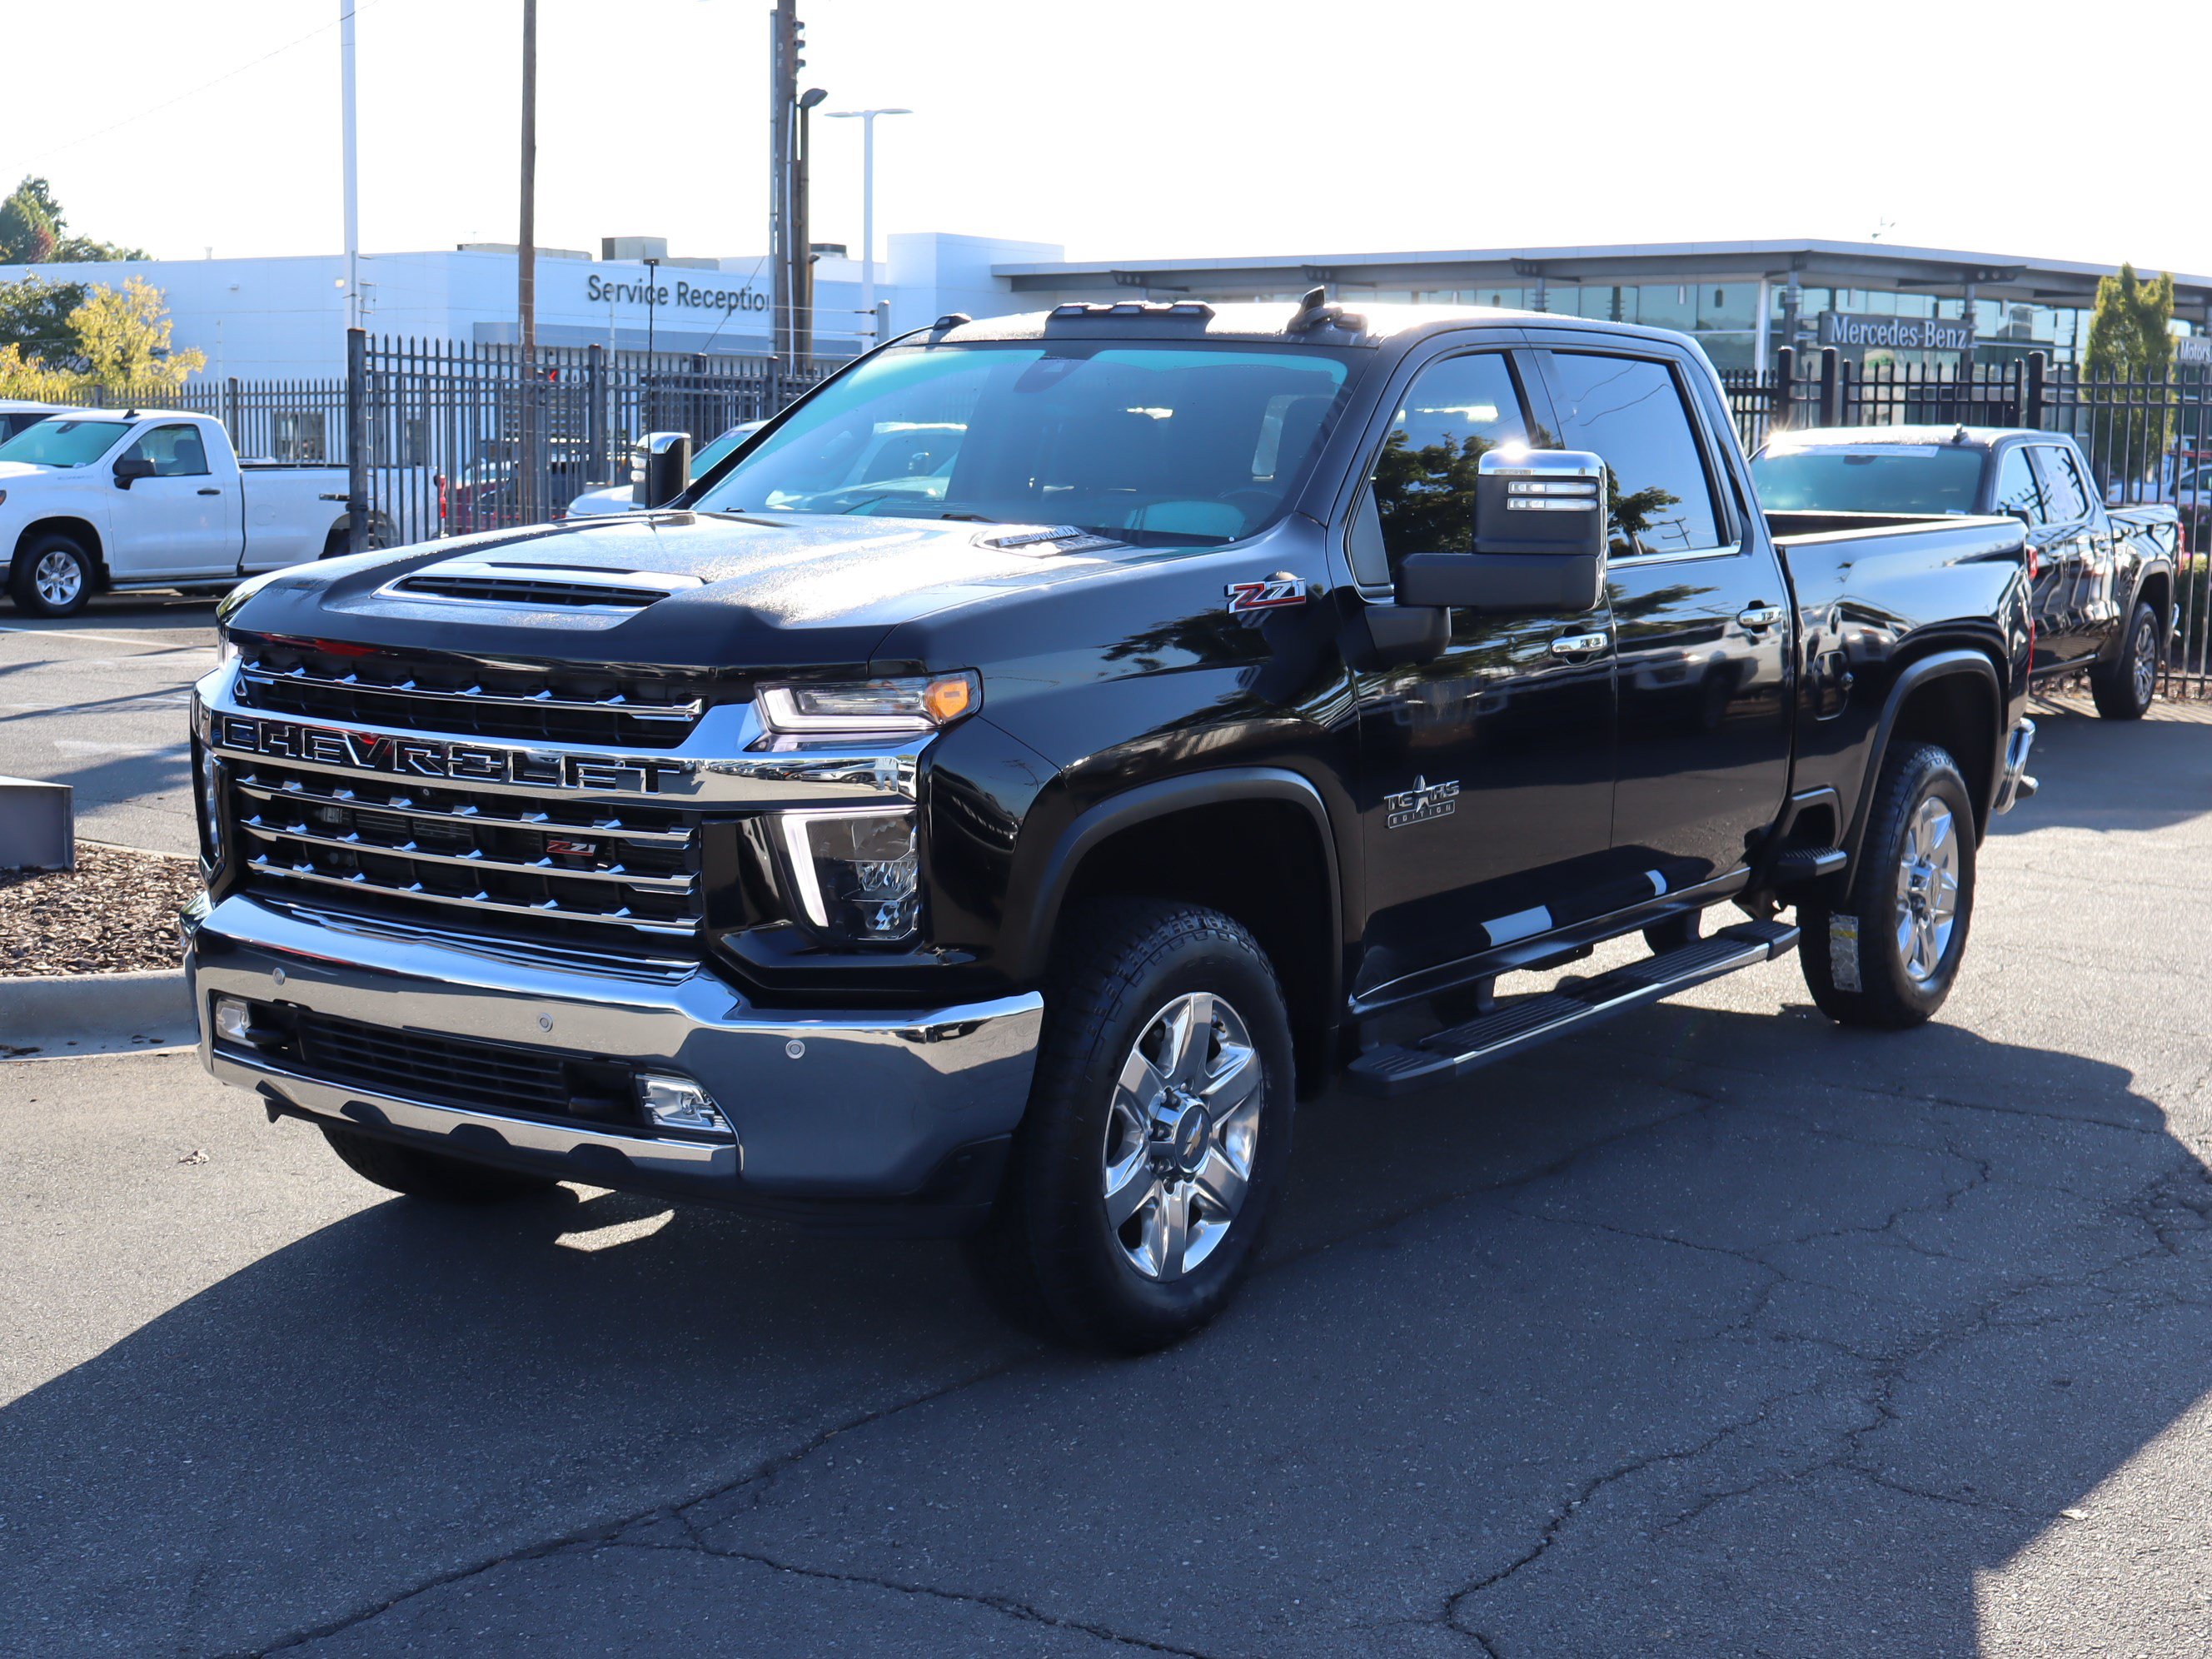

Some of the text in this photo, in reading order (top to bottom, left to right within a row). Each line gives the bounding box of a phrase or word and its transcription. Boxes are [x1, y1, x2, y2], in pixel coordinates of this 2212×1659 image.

[588, 274, 669, 305] Service
[1831, 316, 1967, 349] Mercedes-Benz
[2180, 340, 2210, 361] Motors
[1226, 578, 1306, 614] Z71
[222, 716, 680, 795] CHEVROLET
[1392, 804, 1451, 824] EDITION
[546, 839, 596, 856] Z71
